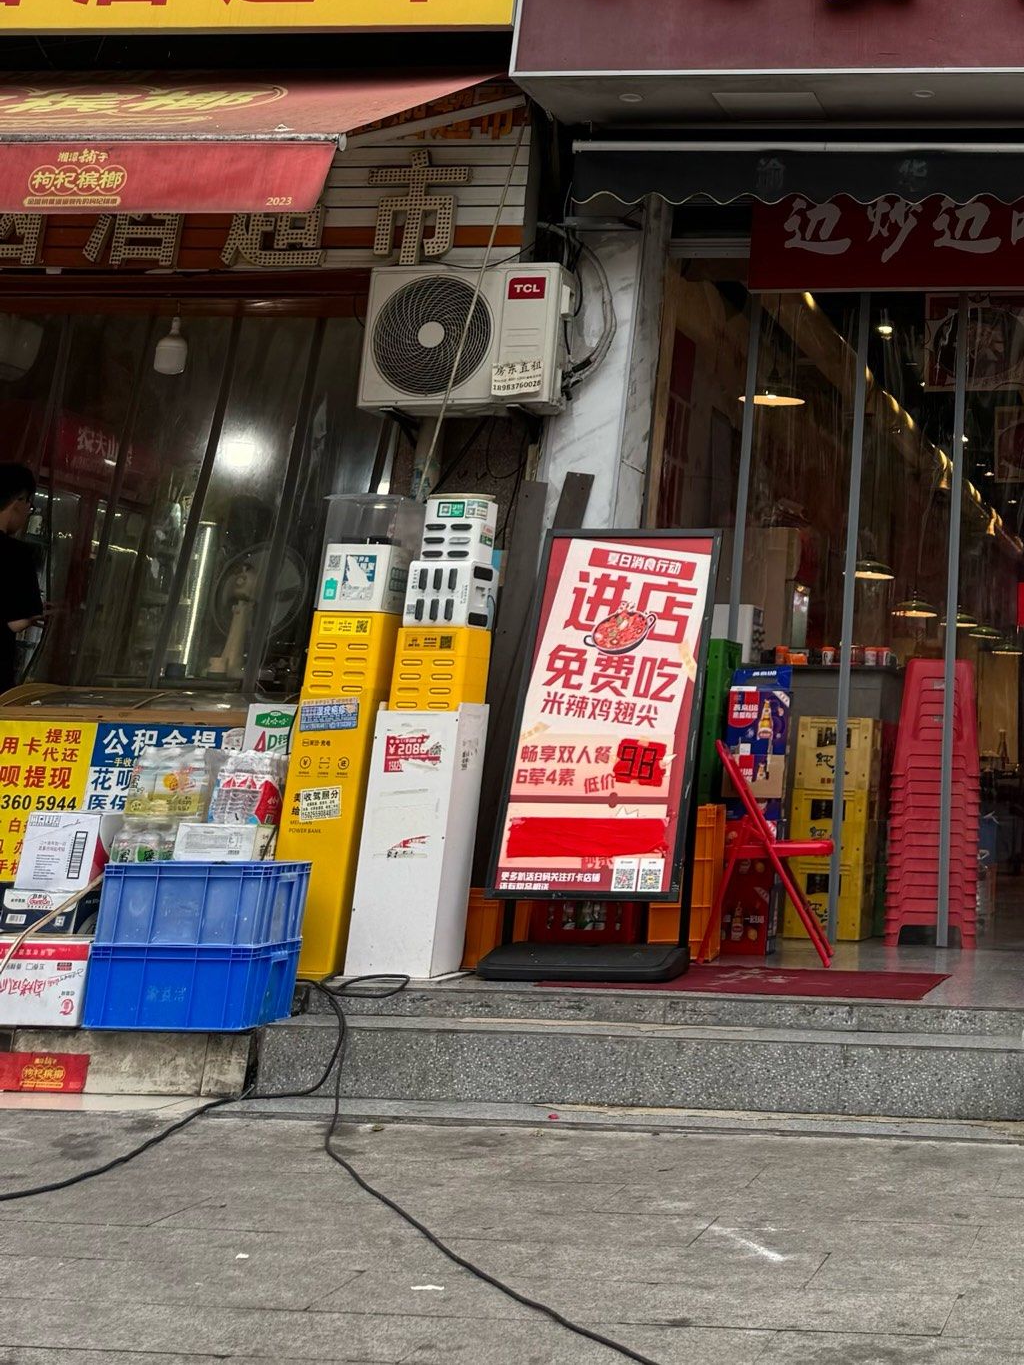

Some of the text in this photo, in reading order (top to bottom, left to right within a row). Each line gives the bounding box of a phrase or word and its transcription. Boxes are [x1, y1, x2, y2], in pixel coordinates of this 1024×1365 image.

[31, 170, 124, 190] 枸杞槟榔
[266, 197, 293, 207] 2023
[514, 284, 540, 293] TCL
[607, 552, 683, 575] 夏日消食行动
[563, 571, 698, 644] 进店
[542, 643, 683, 703] 免费吃
[539, 690, 660, 729] 米辣鸡翅尖
[45, 728, 82, 744] 提现
[103, 728, 224, 756] 公积金提
[43, 747, 79, 763] 代还
[520, 745, 613, 765] 畅享双人餐
[515, 768, 577, 787] 6荤4素
[584, 773, 616, 794] 低价
